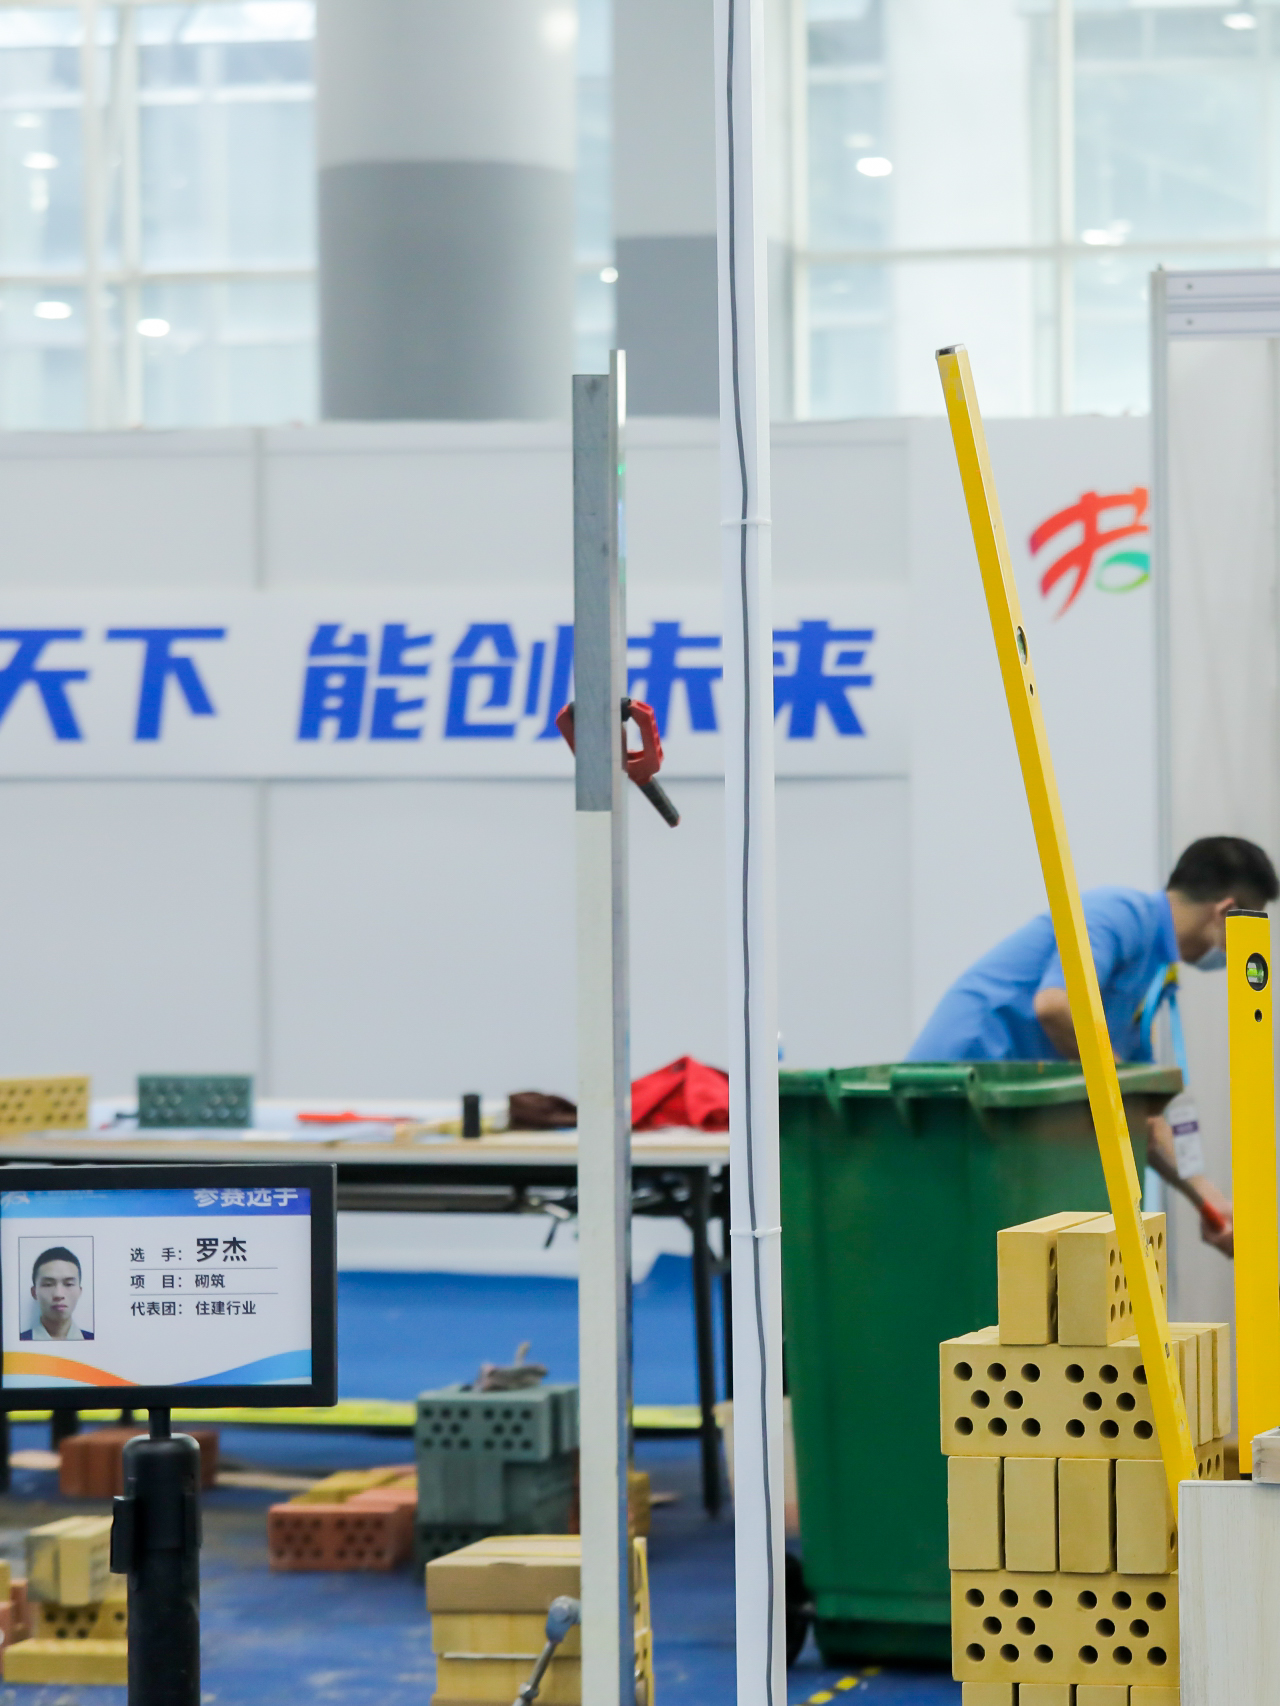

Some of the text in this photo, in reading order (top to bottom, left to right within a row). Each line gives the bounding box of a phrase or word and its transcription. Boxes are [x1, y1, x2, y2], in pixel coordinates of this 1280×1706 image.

[294, 620, 876, 742] 能创未来
[196, 1236, 248, 1262] 罗杰
[195, 1273, 226, 1289] 砌筑
[195, 1300, 257, 1316] 住建行业
